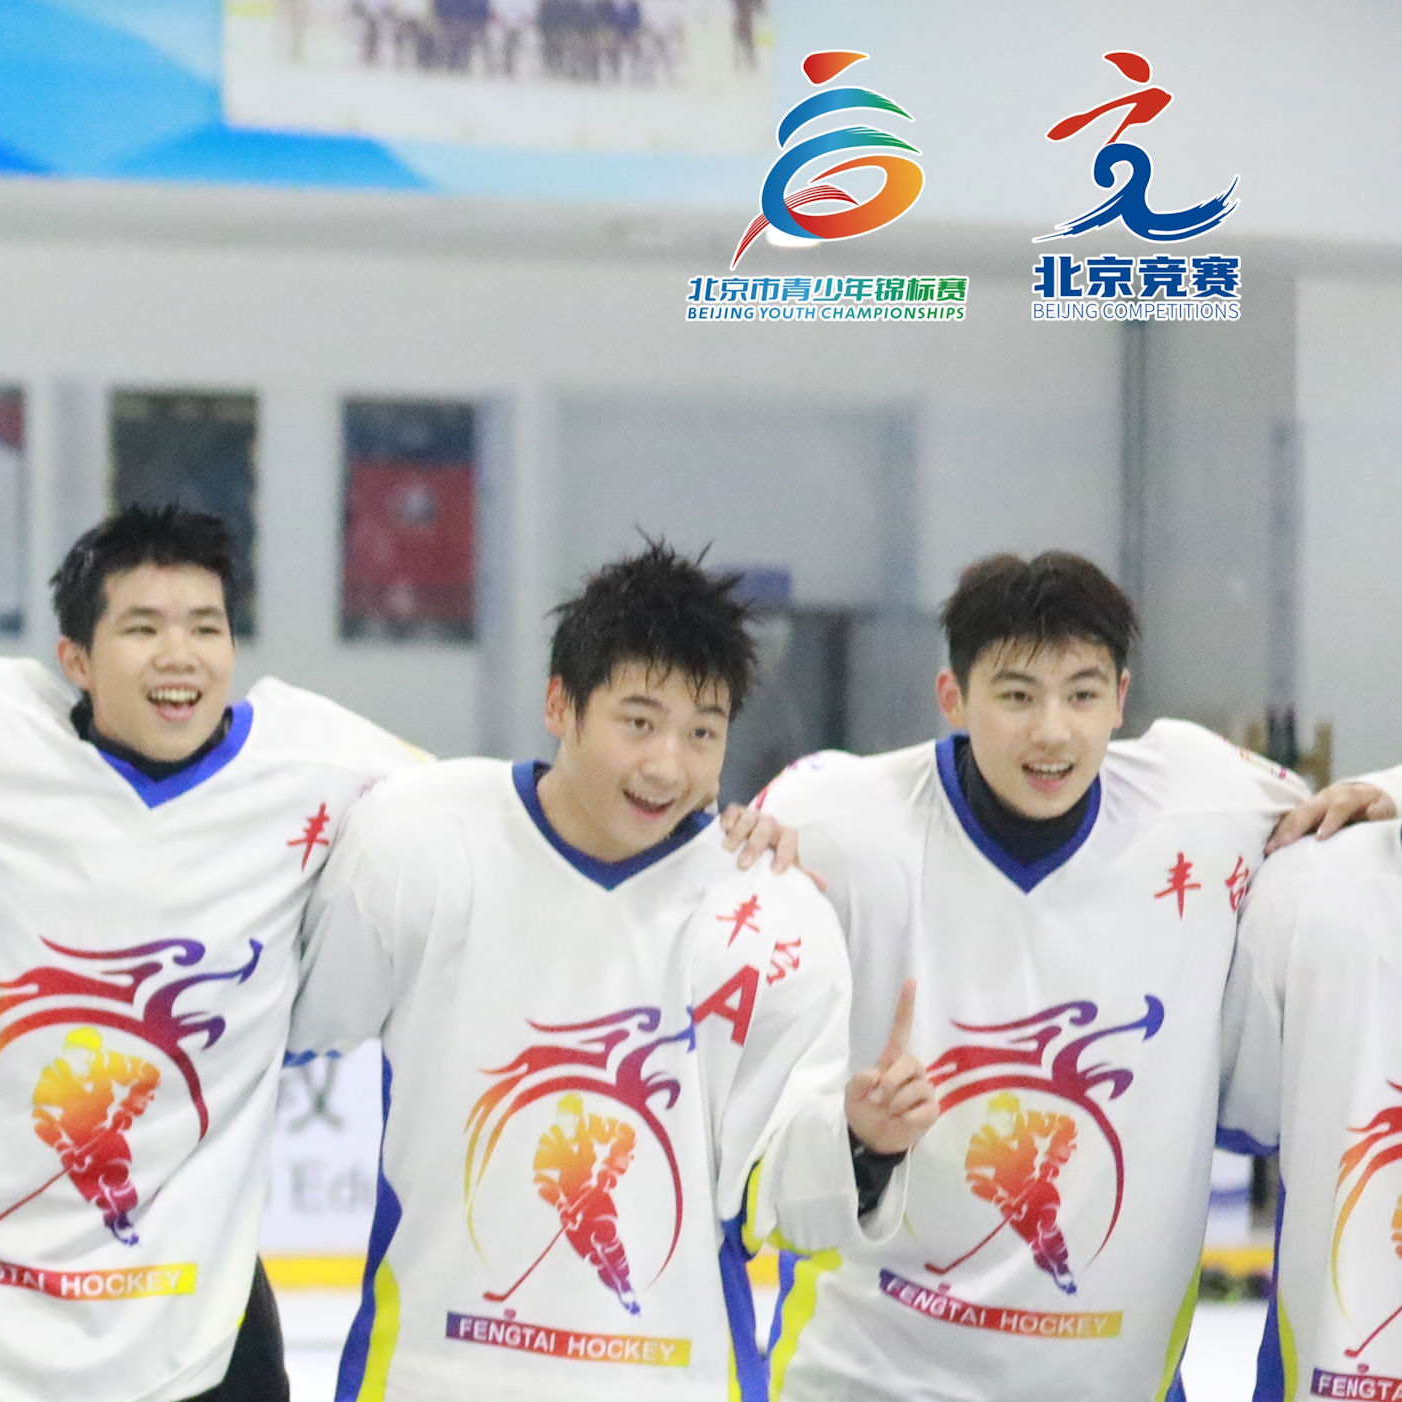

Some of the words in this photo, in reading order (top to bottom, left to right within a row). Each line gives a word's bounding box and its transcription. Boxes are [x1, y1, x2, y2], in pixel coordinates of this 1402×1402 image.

[692, 963, 760, 1048] A
[60, 1269, 182, 1298] HOCKEY
[886, 1277, 988, 1326] FENGTAI
[1000, 1311, 1110, 1335] HOCKEY
[459, 1317, 557, 1353] FENGTAI
[567, 1335, 676, 1363] HOCKEY
